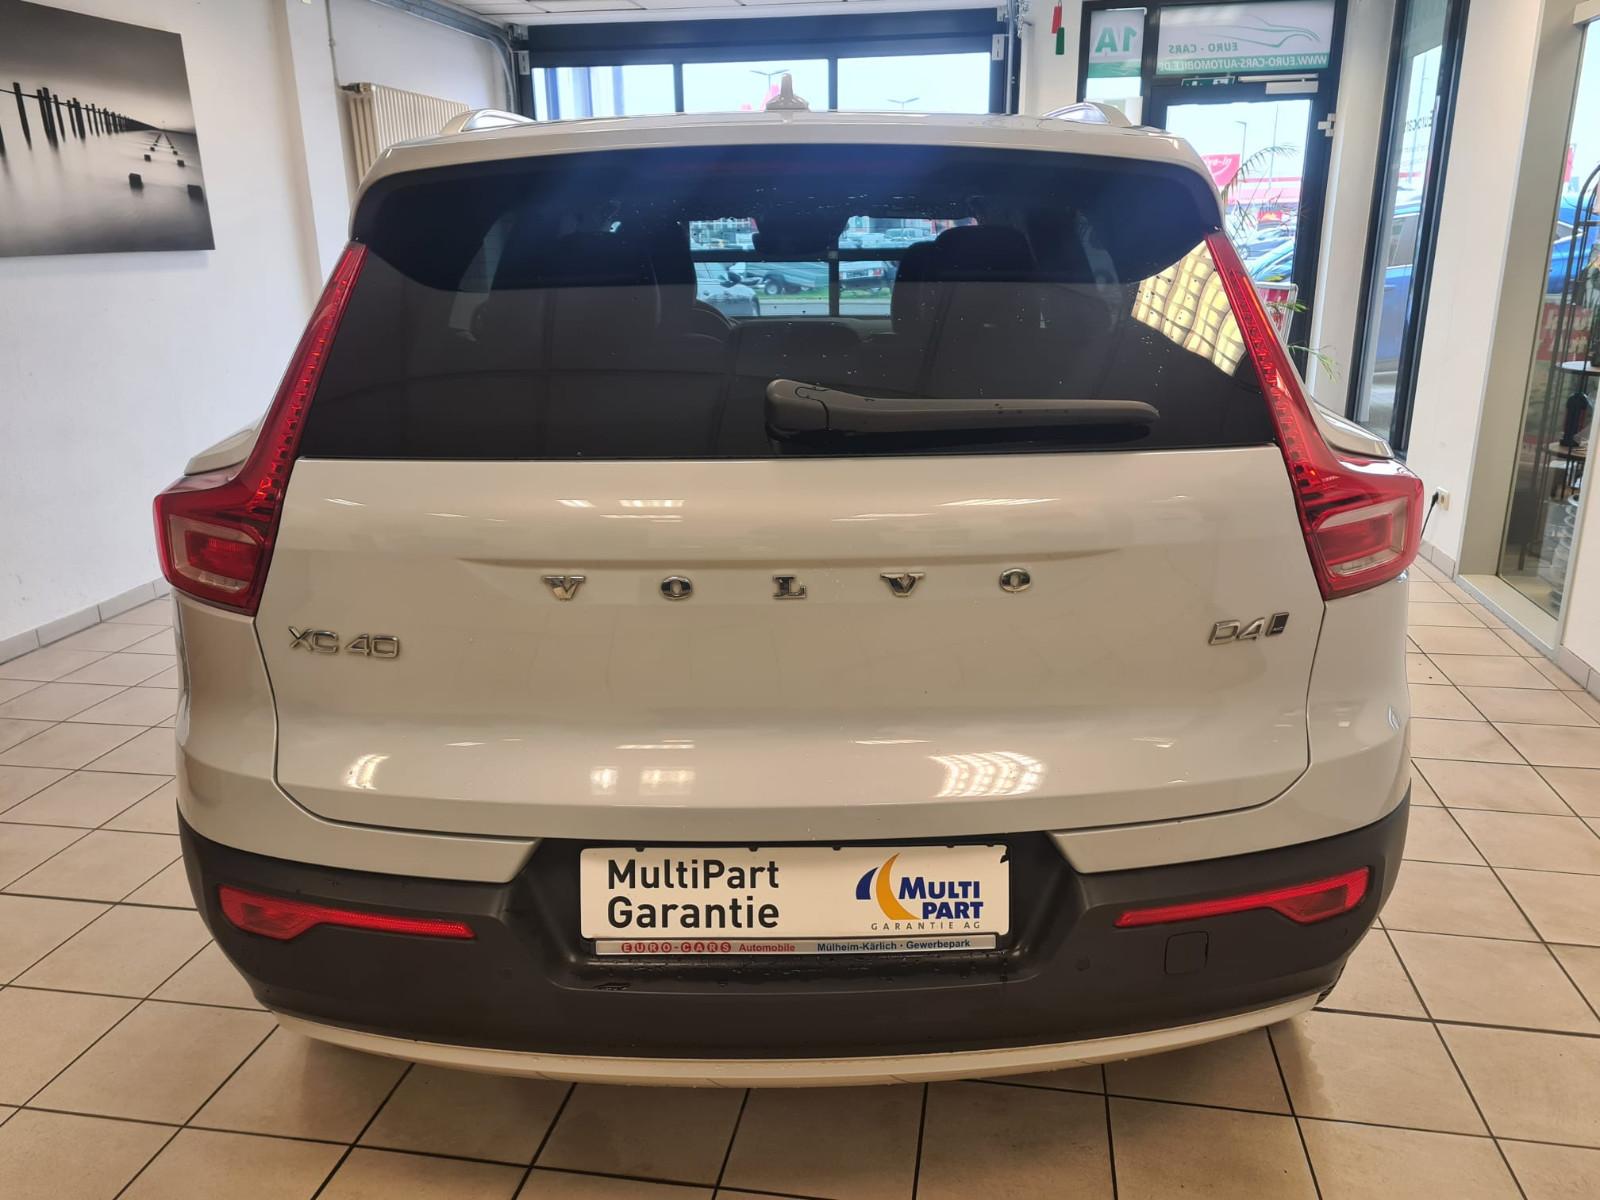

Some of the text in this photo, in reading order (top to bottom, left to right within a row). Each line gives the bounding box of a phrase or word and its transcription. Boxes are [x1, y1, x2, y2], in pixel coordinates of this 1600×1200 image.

[541, 567, 1032, 601] VOLVO
[607, 858, 780, 890] MultiPart
[898, 876, 981, 900] MULTI
[607, 895, 780, 929] Garantie
[922, 901, 984, 920] PART
[871, 921, 981, 931] GARANTIE AG
[621, 939, 971, 954] EURO-CARS Automobile Mülheim-Kärlich Gewerbepark
